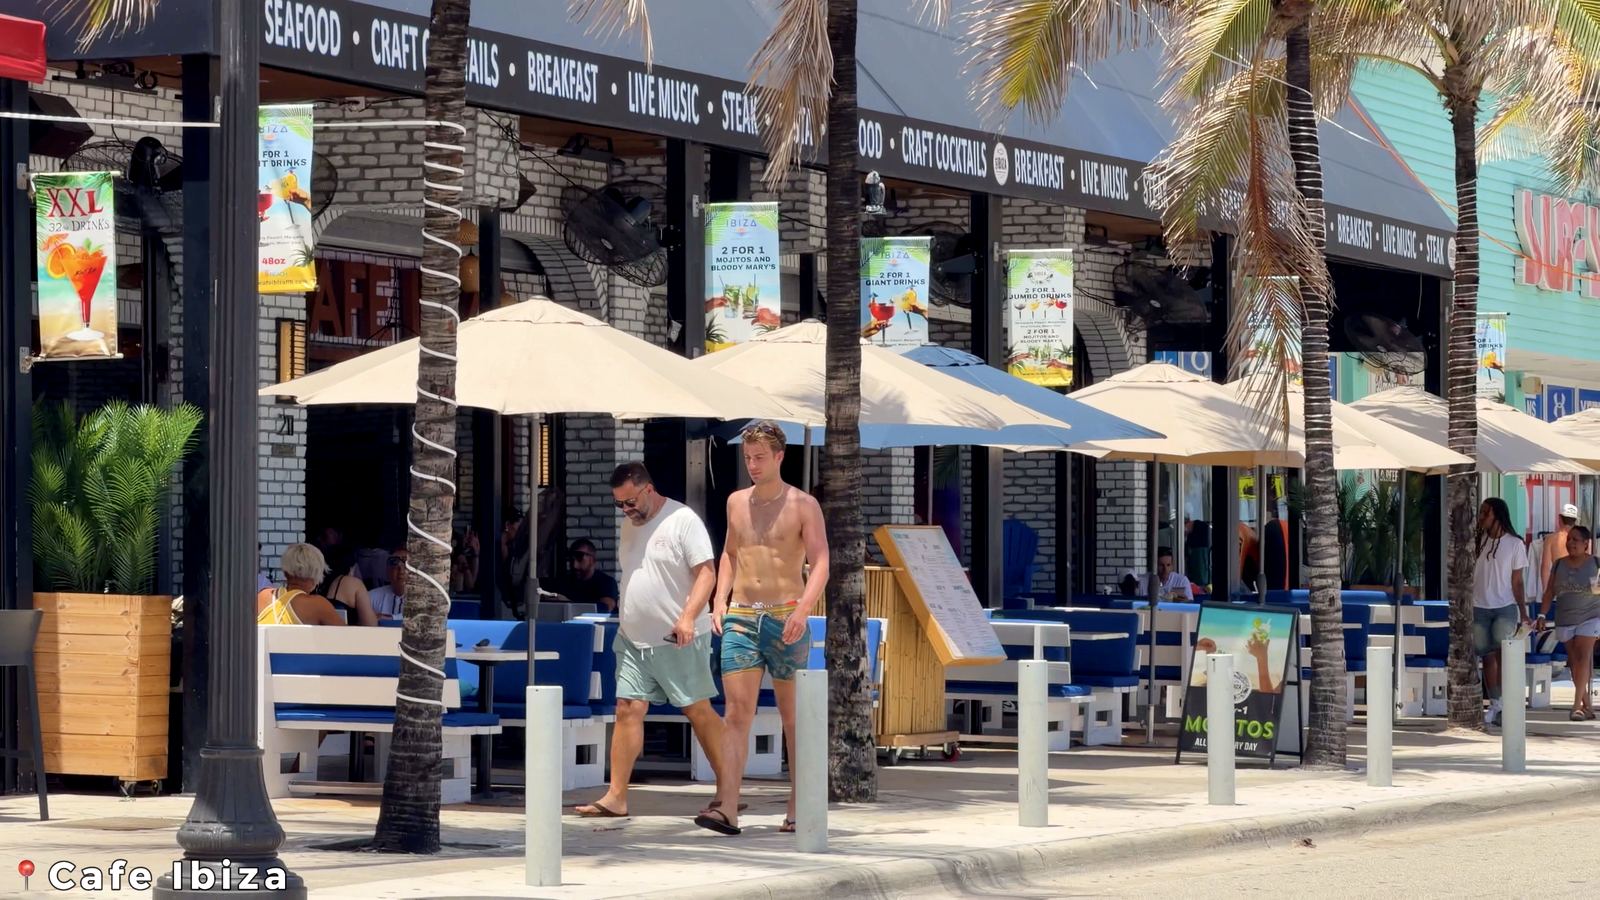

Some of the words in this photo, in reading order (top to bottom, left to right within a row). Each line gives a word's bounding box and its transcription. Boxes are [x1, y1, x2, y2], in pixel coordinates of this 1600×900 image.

[264, 0, 341, 57] SEAFOOD
[371, 18, 419, 71] CRAFT
[527, 50, 599, 104] BREAKFAST
[628, 71, 655, 115] LIVE
[657, 78, 700, 126] MUSIC
[901, 125, 934, 169] CRAFT
[935, 132, 987, 178] COCKTAILS
[1014, 148, 1065, 190] BREAKFAST
[1080, 159, 1100, 195] LIVE
[1100, 164, 1129, 201] MUSIC
[262, 150, 281, 158] FOR
[284, 150, 290, 158] 1
[271, 158, 307, 167] DRINKS
[46, 187, 104, 218] XXL
[1337, 213, 1373, 250] BREAKFAST
[1382, 223, 1397, 252] LIVE
[1397, 227, 1417, 260] MUSIC
[1426, 233, 1445, 265] STEAK
[721, 246, 728, 255] 2
[731, 246, 754, 255] FOR
[759, 246, 765, 255] 1
[716, 256, 752, 264] MOJITOS
[711, 264, 742, 272] BLOODY
[745, 263, 776, 271] MARY'S
[893, 278, 926, 286] DRINKS
[1244, 741, 1258, 751] DAY
